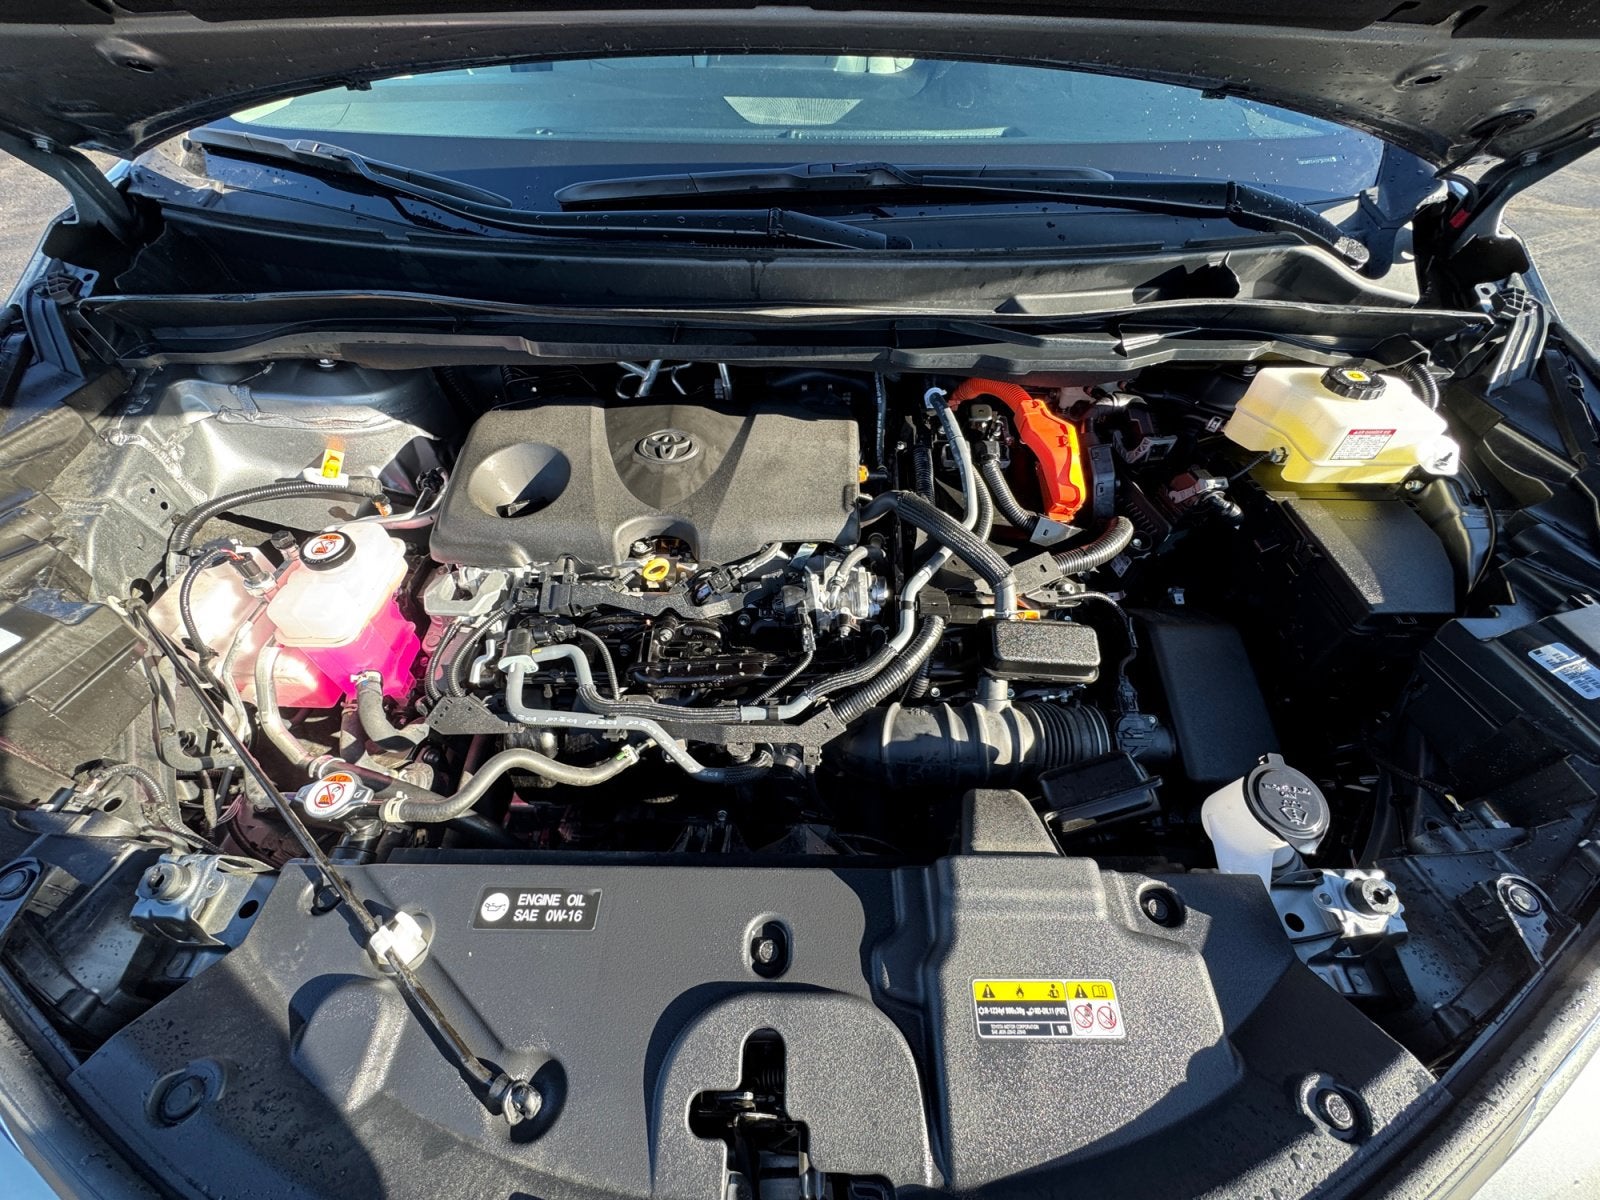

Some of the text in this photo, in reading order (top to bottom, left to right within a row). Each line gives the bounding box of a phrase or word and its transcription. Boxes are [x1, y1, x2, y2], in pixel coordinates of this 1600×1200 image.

[517, 893, 586, 907] ENGINE OIL
[513, 909, 583, 922] SAE 0W-16
